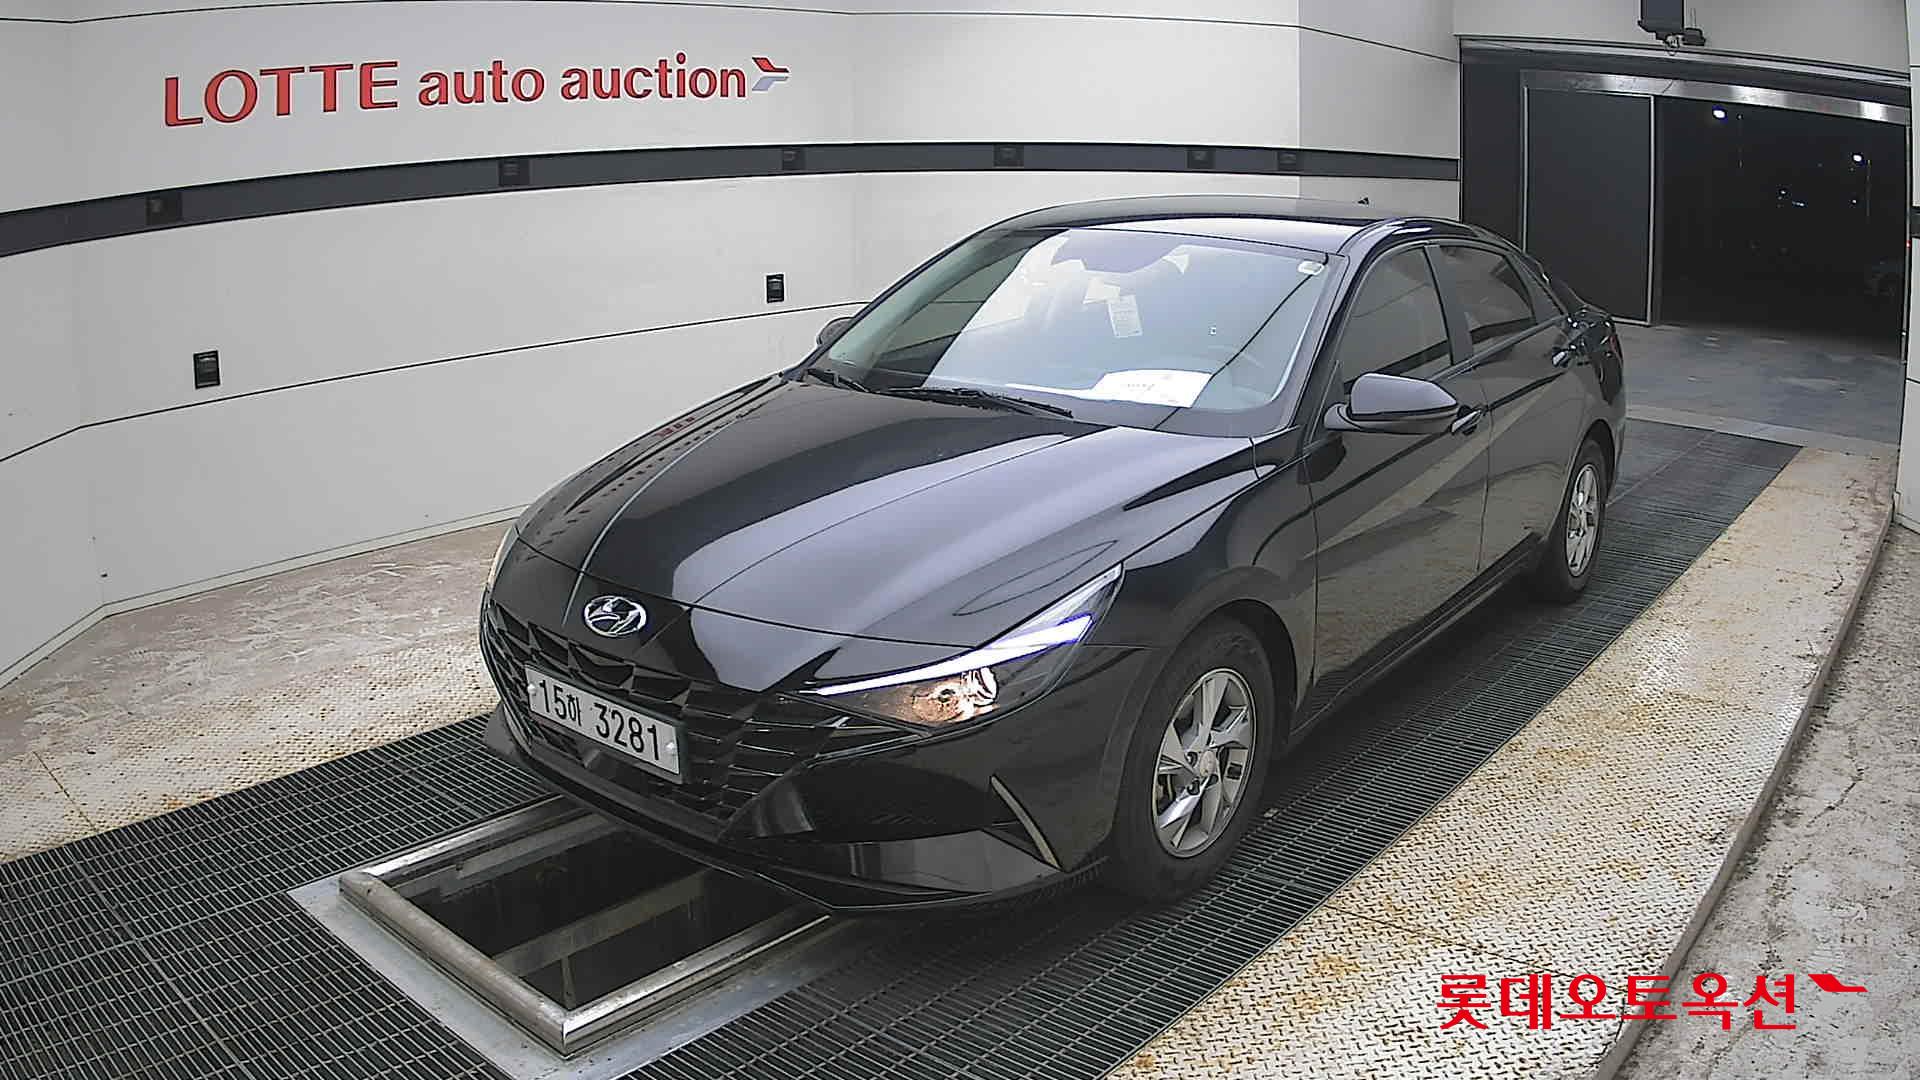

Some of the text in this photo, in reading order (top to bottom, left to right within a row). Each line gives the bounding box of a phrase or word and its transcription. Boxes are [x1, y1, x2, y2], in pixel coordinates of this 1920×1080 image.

[164, 53, 747, 126] LOTTE auto auction
[539, 679, 660, 761] 15하 3281
